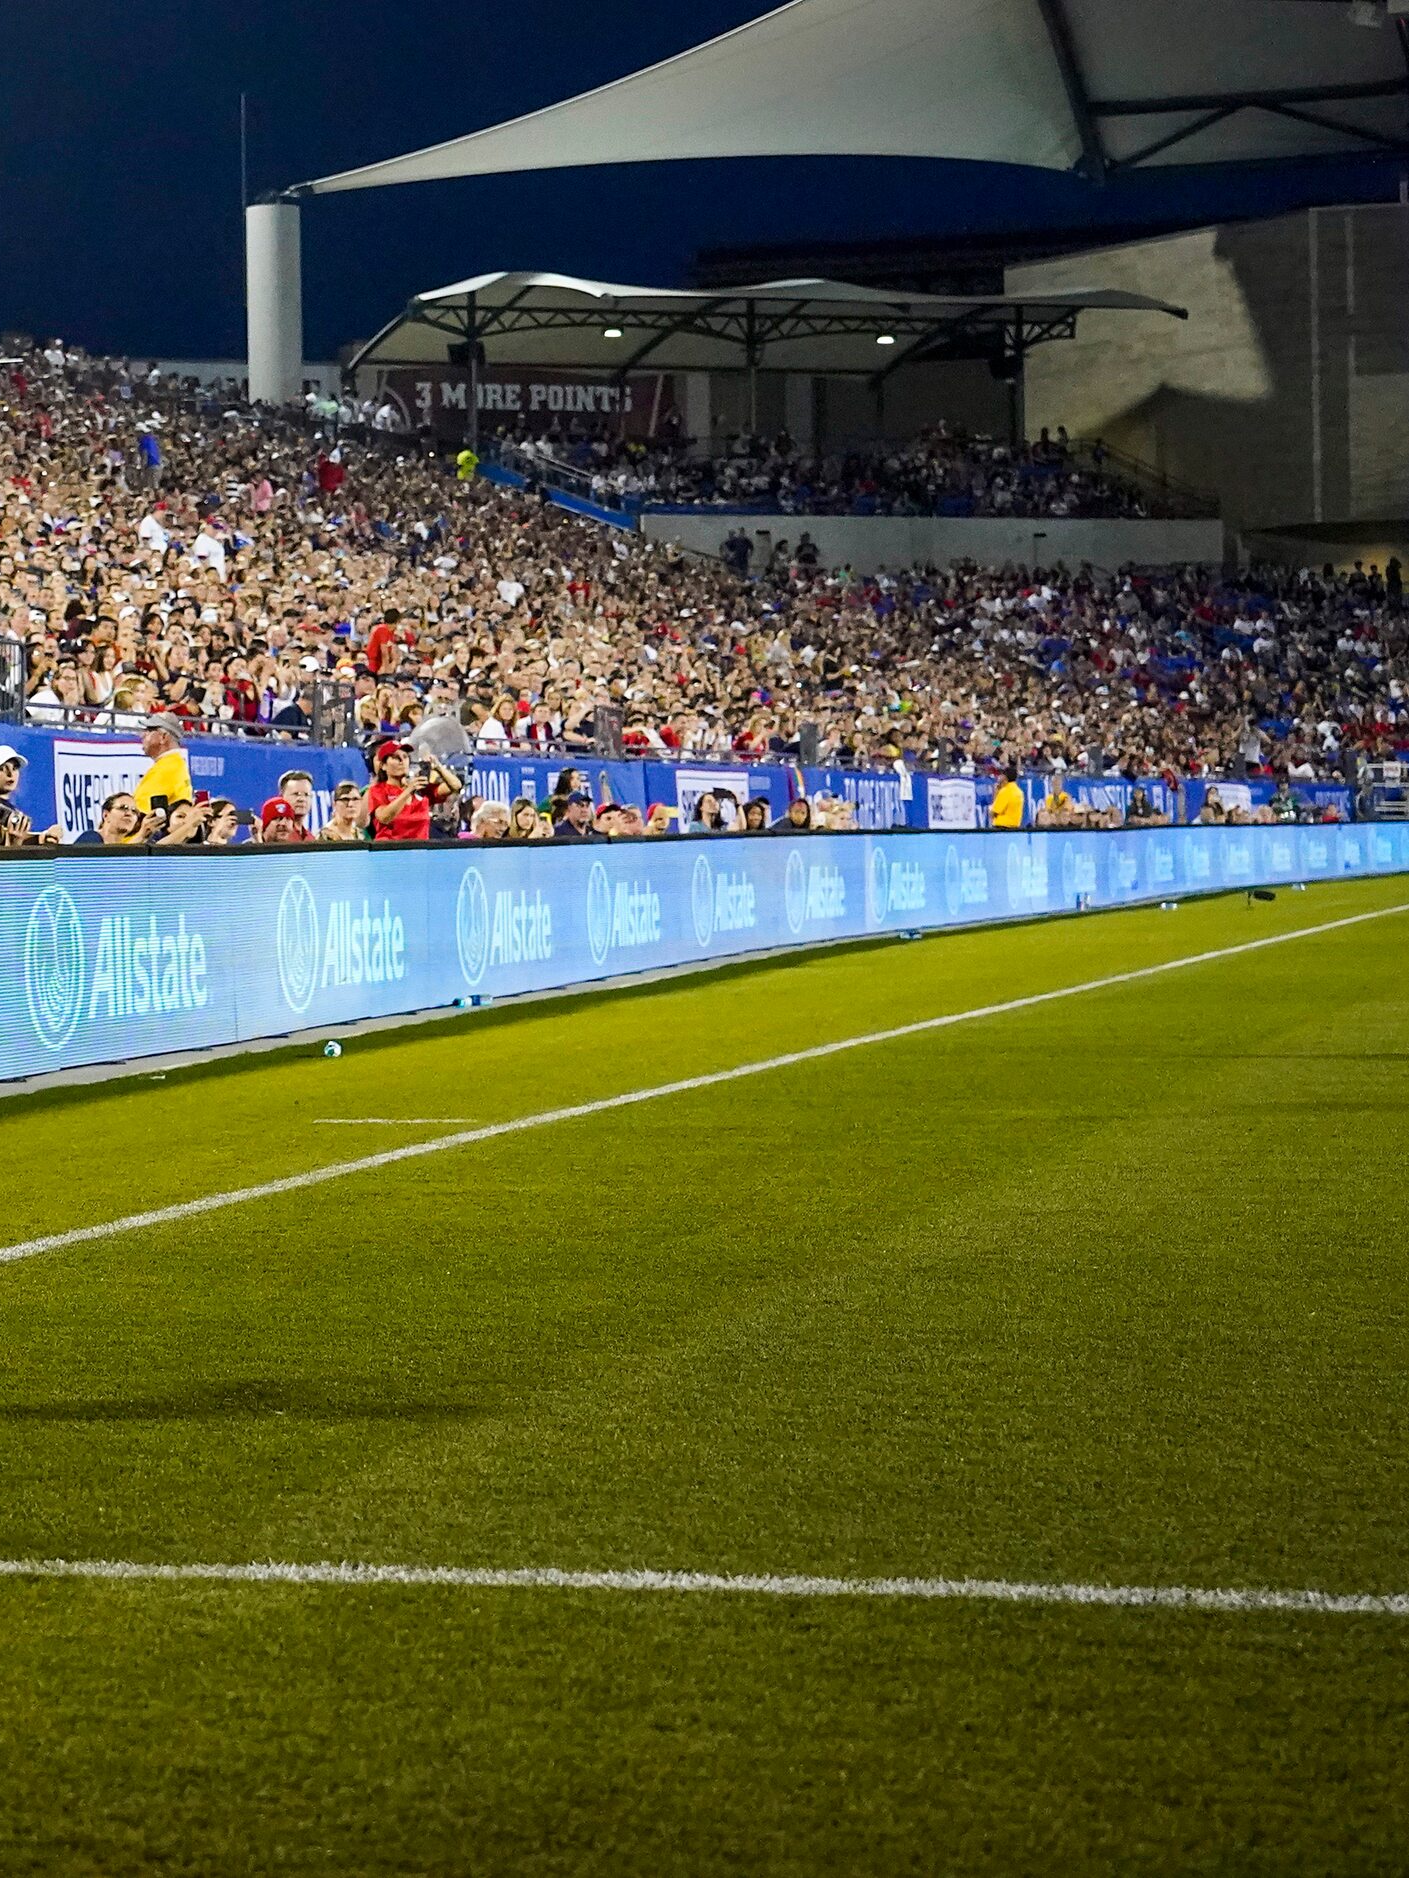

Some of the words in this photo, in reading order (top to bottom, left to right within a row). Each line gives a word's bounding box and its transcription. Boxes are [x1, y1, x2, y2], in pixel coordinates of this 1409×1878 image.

[415, 382, 432, 408] 3
[489, 889, 552, 966] Allstate
[611, 879, 661, 948] Allstate
[713, 871, 756, 932] Allstate
[89, 913, 211, 1019] Allstate
[321, 898, 405, 989] Allstate
